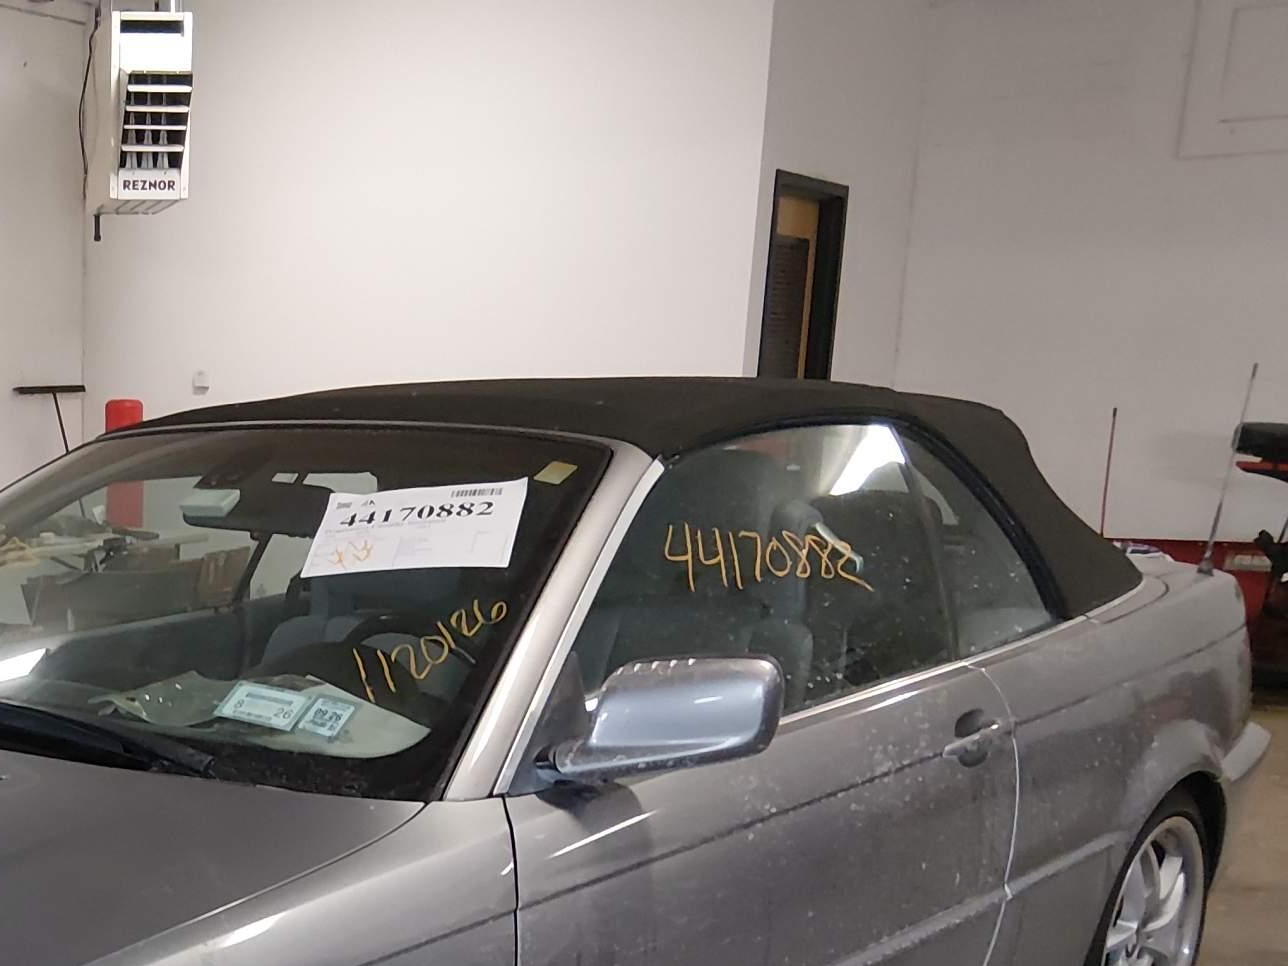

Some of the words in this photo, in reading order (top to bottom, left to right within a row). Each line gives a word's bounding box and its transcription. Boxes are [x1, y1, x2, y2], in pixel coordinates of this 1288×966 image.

[123, 179, 175, 191] REZNOR
[339, 501, 495, 527] 44170882
[664, 521, 875, 592] 44170882
